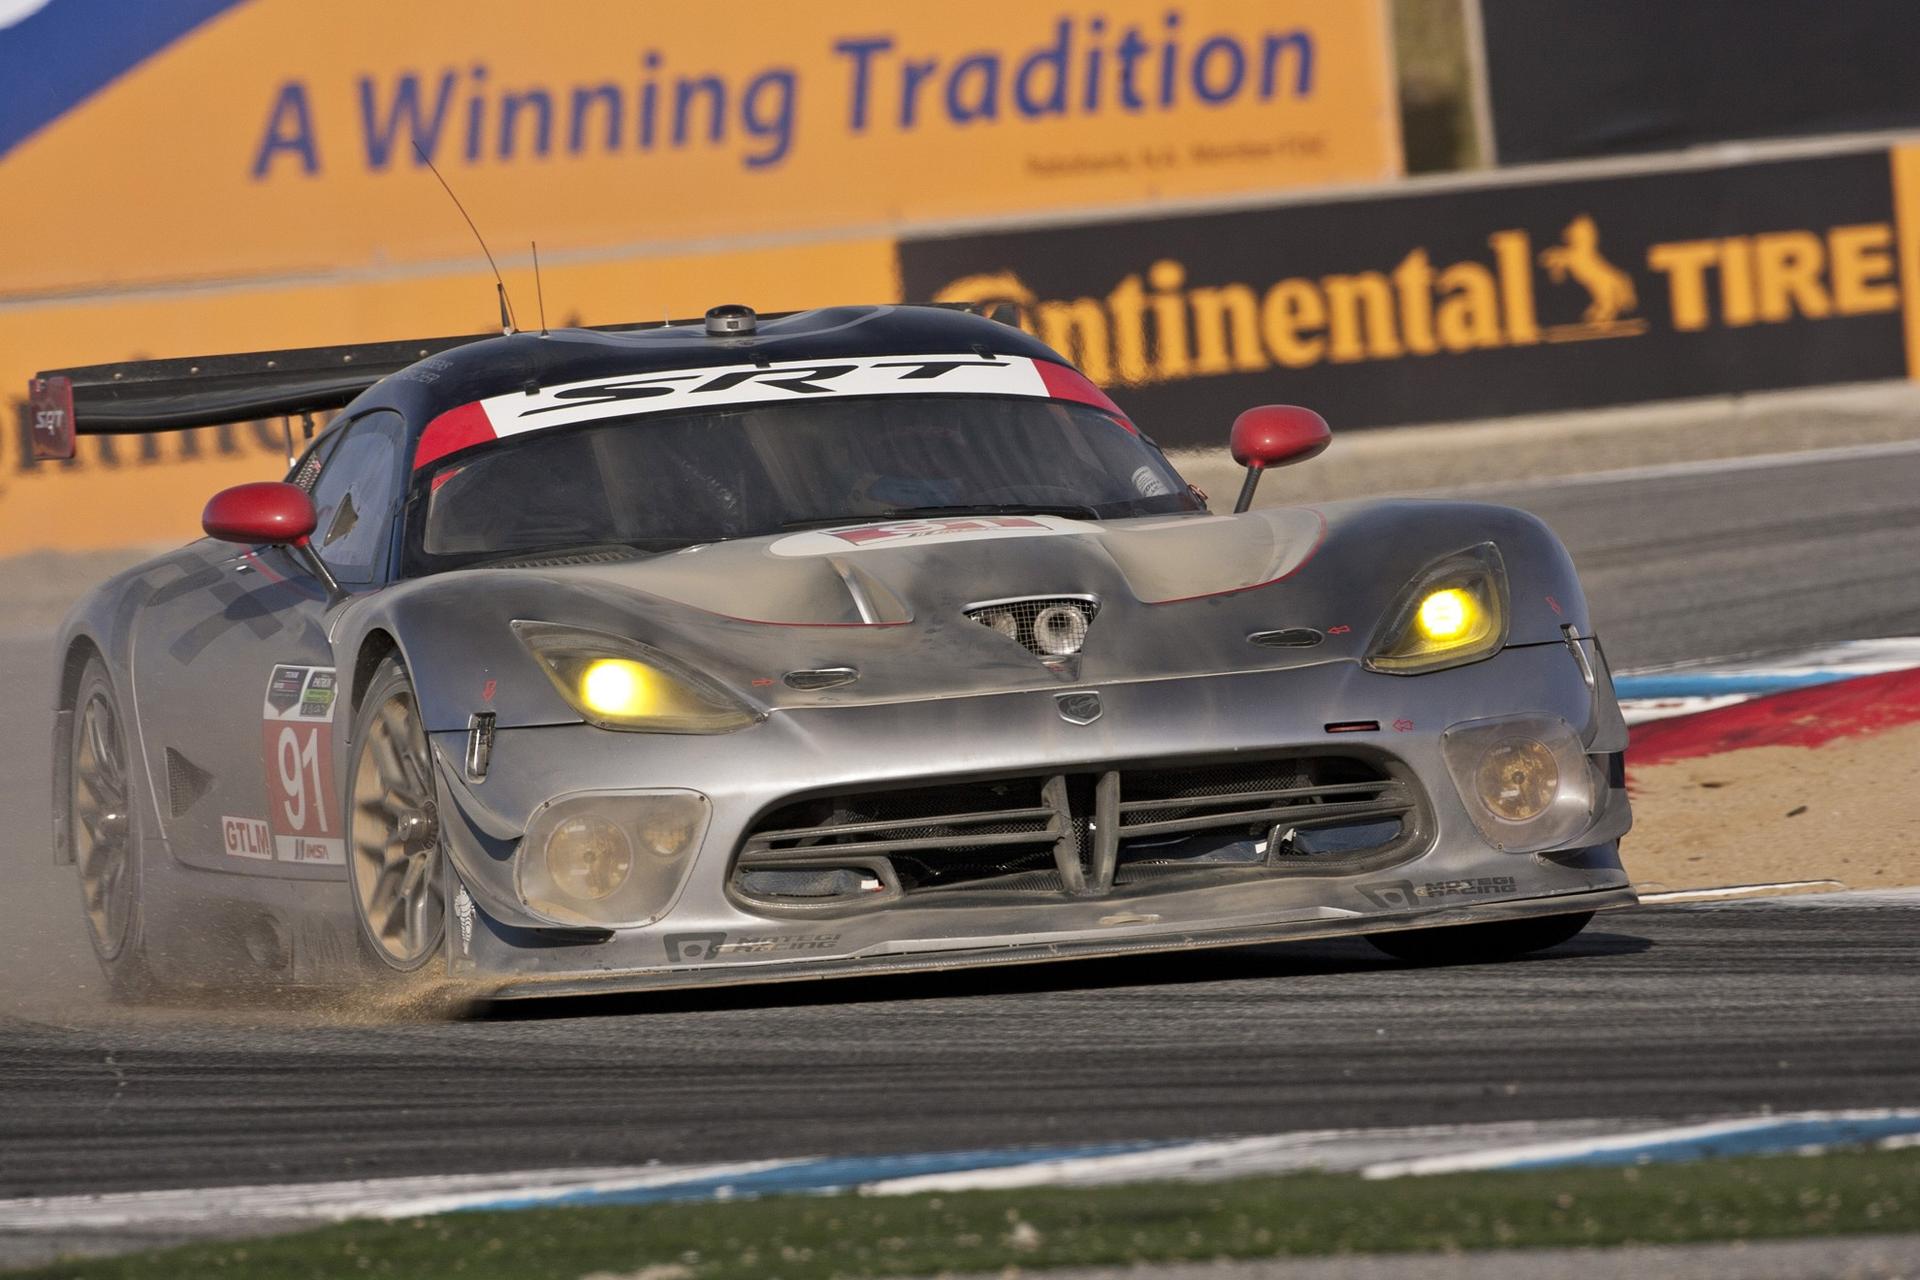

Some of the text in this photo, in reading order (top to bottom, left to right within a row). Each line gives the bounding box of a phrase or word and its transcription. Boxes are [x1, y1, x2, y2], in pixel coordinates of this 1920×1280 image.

[250, 9, 1317, 180] A Winning Tradition
[1648, 222, 1898, 332] TIRE
[518, 361, 1011, 417] SRT
[278, 726, 329, 832] 91
[226, 820, 271, 857] GTLM
